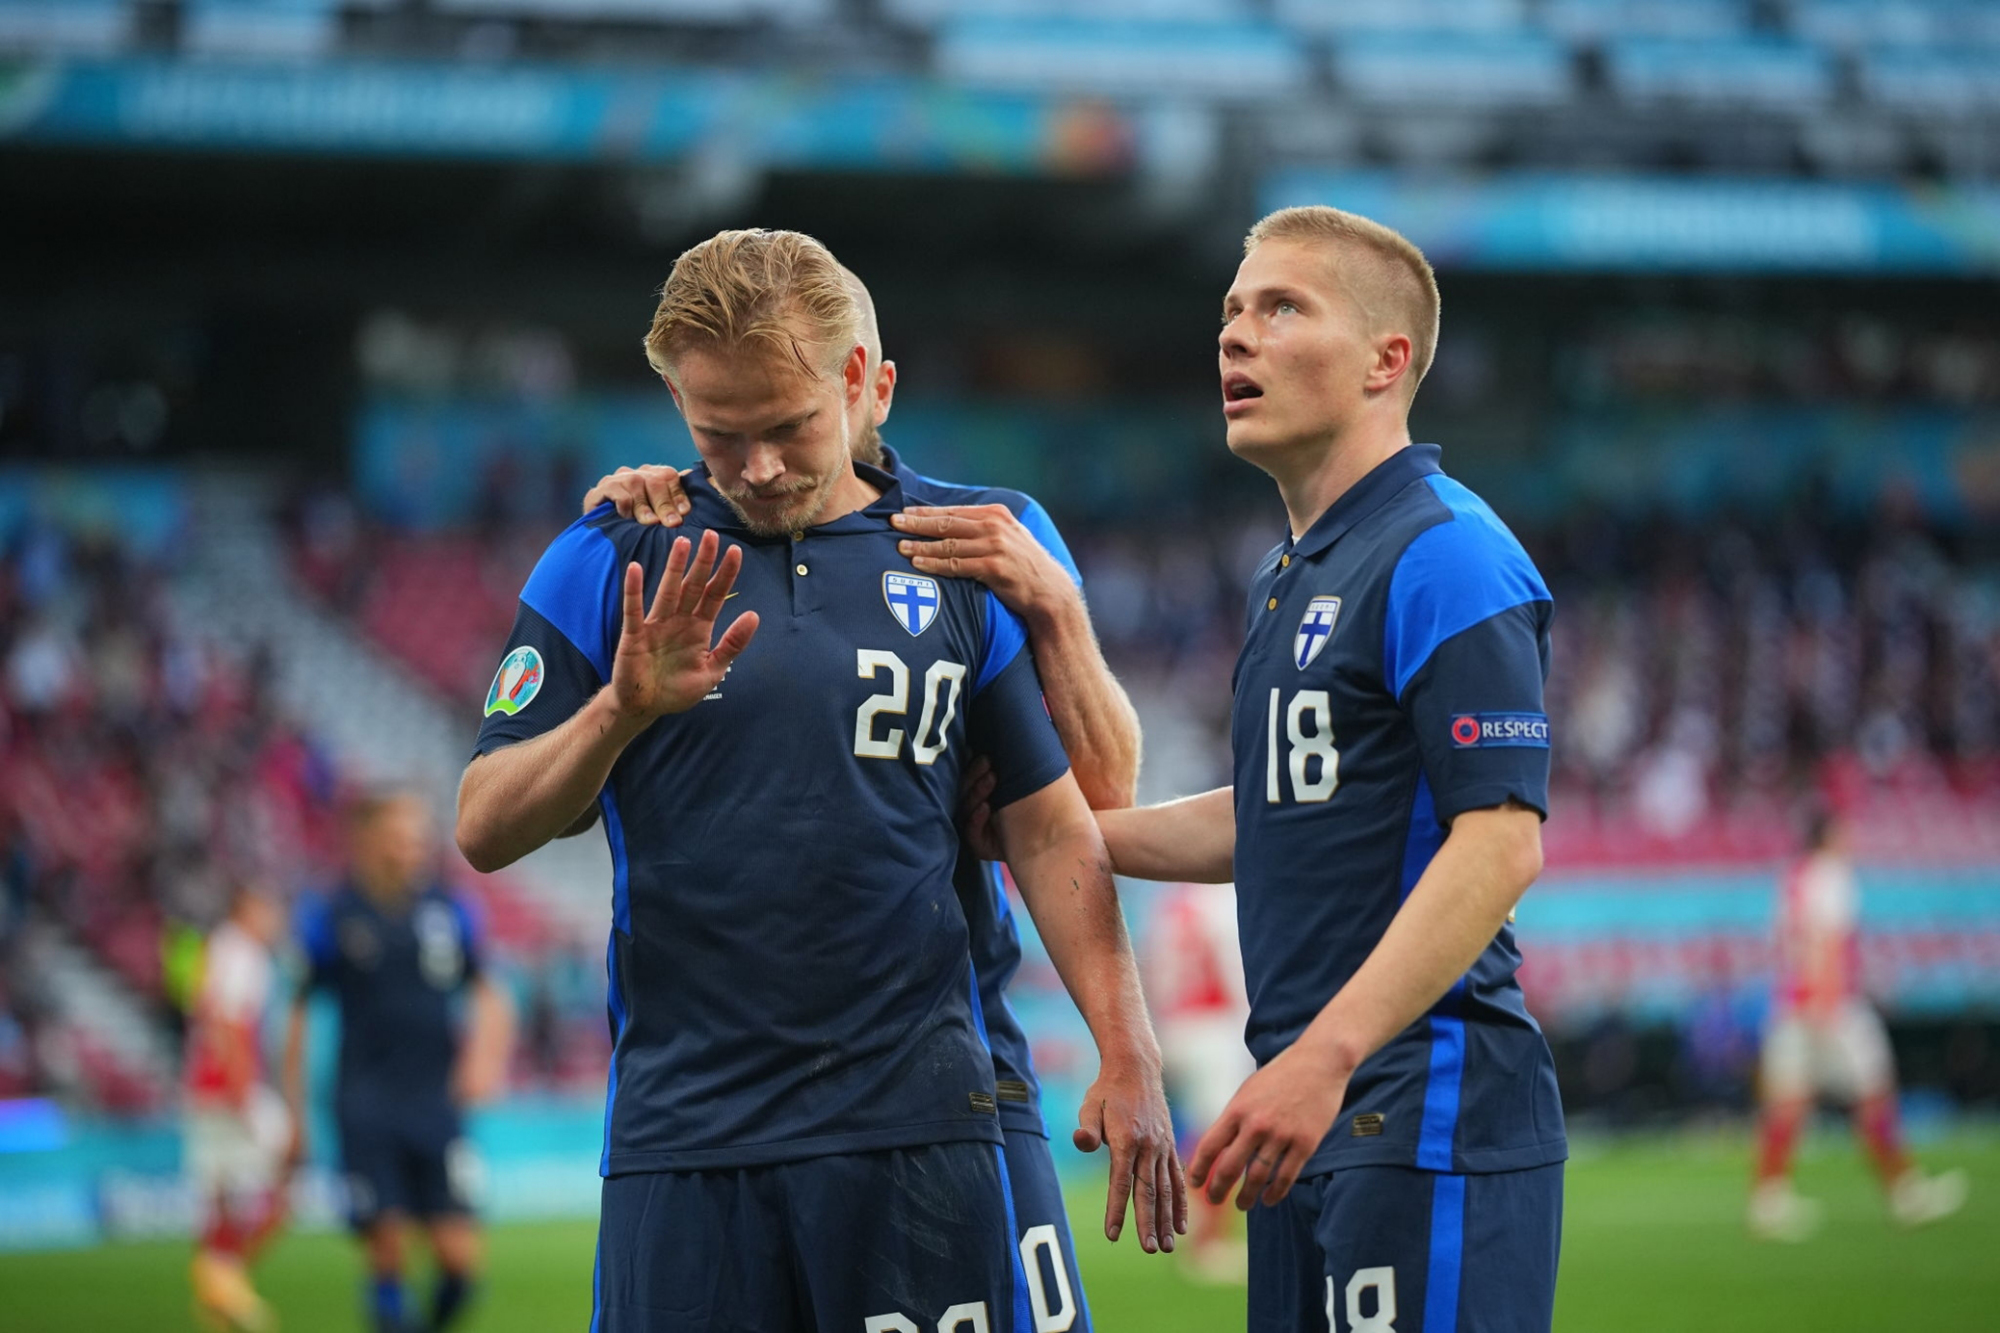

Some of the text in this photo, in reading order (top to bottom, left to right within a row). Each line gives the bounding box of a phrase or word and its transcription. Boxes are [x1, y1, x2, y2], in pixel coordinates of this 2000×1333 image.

[892, 577, 929, 587] SUOMI
[854, 648, 967, 765] 20
[1482, 721, 1548, 739] RESPECT
[1267, 687, 1339, 803] 18
